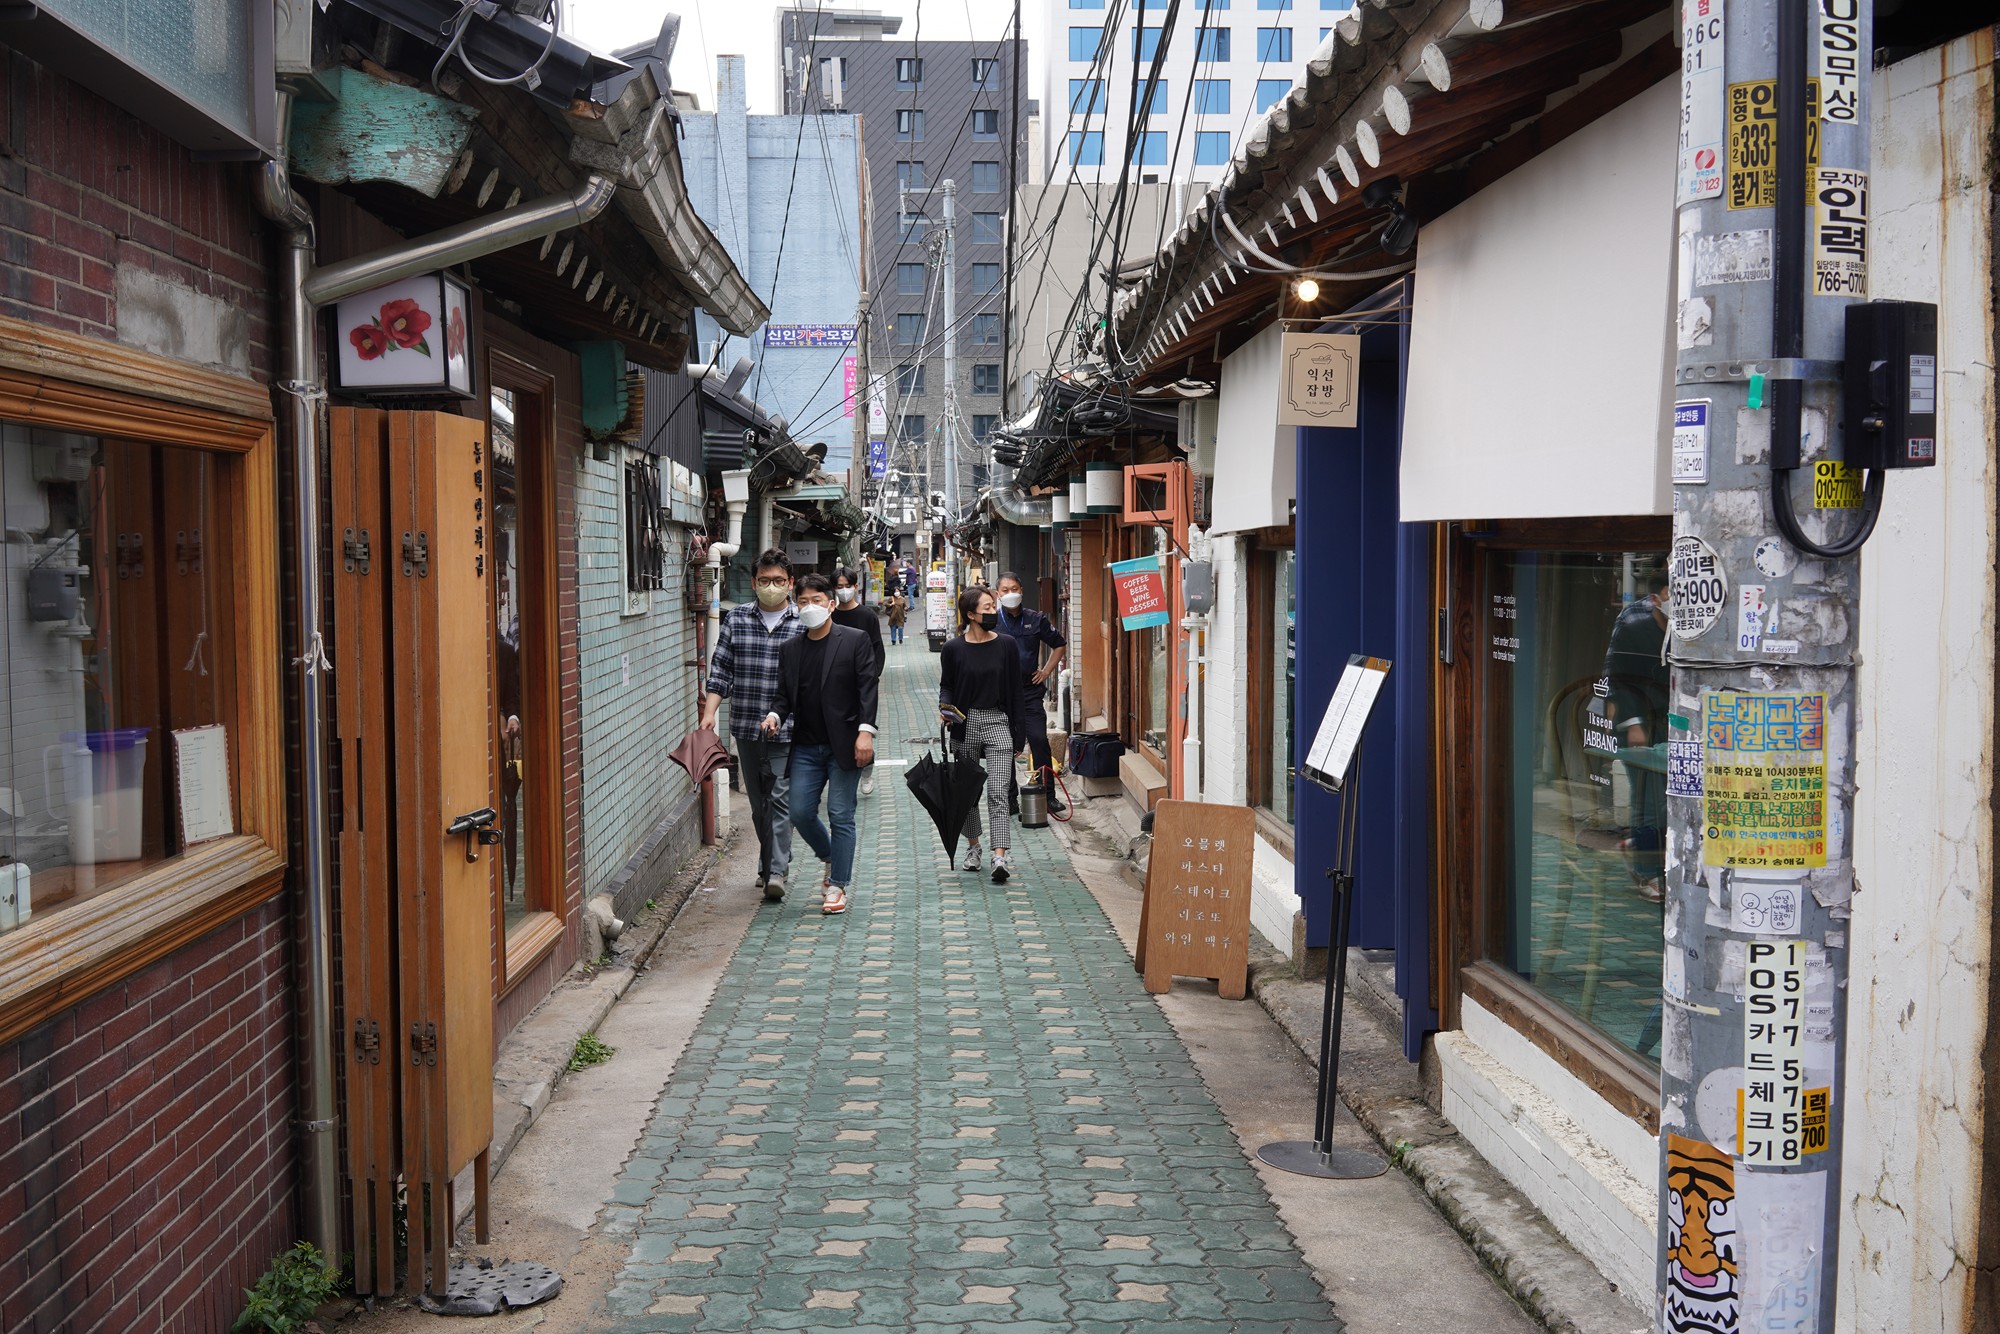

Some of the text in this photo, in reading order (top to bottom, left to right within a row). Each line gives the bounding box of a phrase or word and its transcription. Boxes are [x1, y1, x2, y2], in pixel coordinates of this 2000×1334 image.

[1733, 87, 1748, 123] 한영
[1705, 177, 1720, 190] 123
[1732, 170, 1760, 206] 철거
[1818, 171, 1868, 190] 무지개
[1818, 187, 1867, 262] 인력
[1816, 260, 1841, 271] 일당인부
[1816, 271, 1867, 295] 766-0700
[767, 329, 854, 342] 신인가수모집
[1307, 368, 1334, 382] 익선
[1306, 384, 1335, 398] 잡방
[1674, 555, 1715, 580] 미인력
[1122, 574, 1150, 589] COFFEE
[1129, 584, 1149, 595] BEER
[1129, 597, 1159, 614] DESSERT
[1132, 592, 1151, 604] WINE
[1688, 606, 1716, 619] 필요한
[1675, 619, 1704, 631] 모든곳에
[1708, 695, 1823, 724] 노래교실
[1583, 729, 1618, 754] JABBANG
[1707, 722, 1823, 752] 회원모집
[1734, 767, 1763, 777] 화요일
[1766, 766, 1823, 777] 10시30분부터
[1770, 777, 1823, 791] 음치탈출
[1773, 792, 1806, 800] 건강하게
[1808, 791, 1823, 800] 살자
[1782, 812, 1822, 828] 기념음반
[1721, 829, 1736, 839] (사)
[1182, 837, 1225, 852] 오믈렛
[1181, 860, 1225, 876] 파스타
[1727, 857, 1805, 866] 종로3가 송해길
[1172, 884, 1231, 900] 스테이크
[1774, 895, 1790, 905] 안녕
[1164, 932, 1232, 950] 와인 맥주
